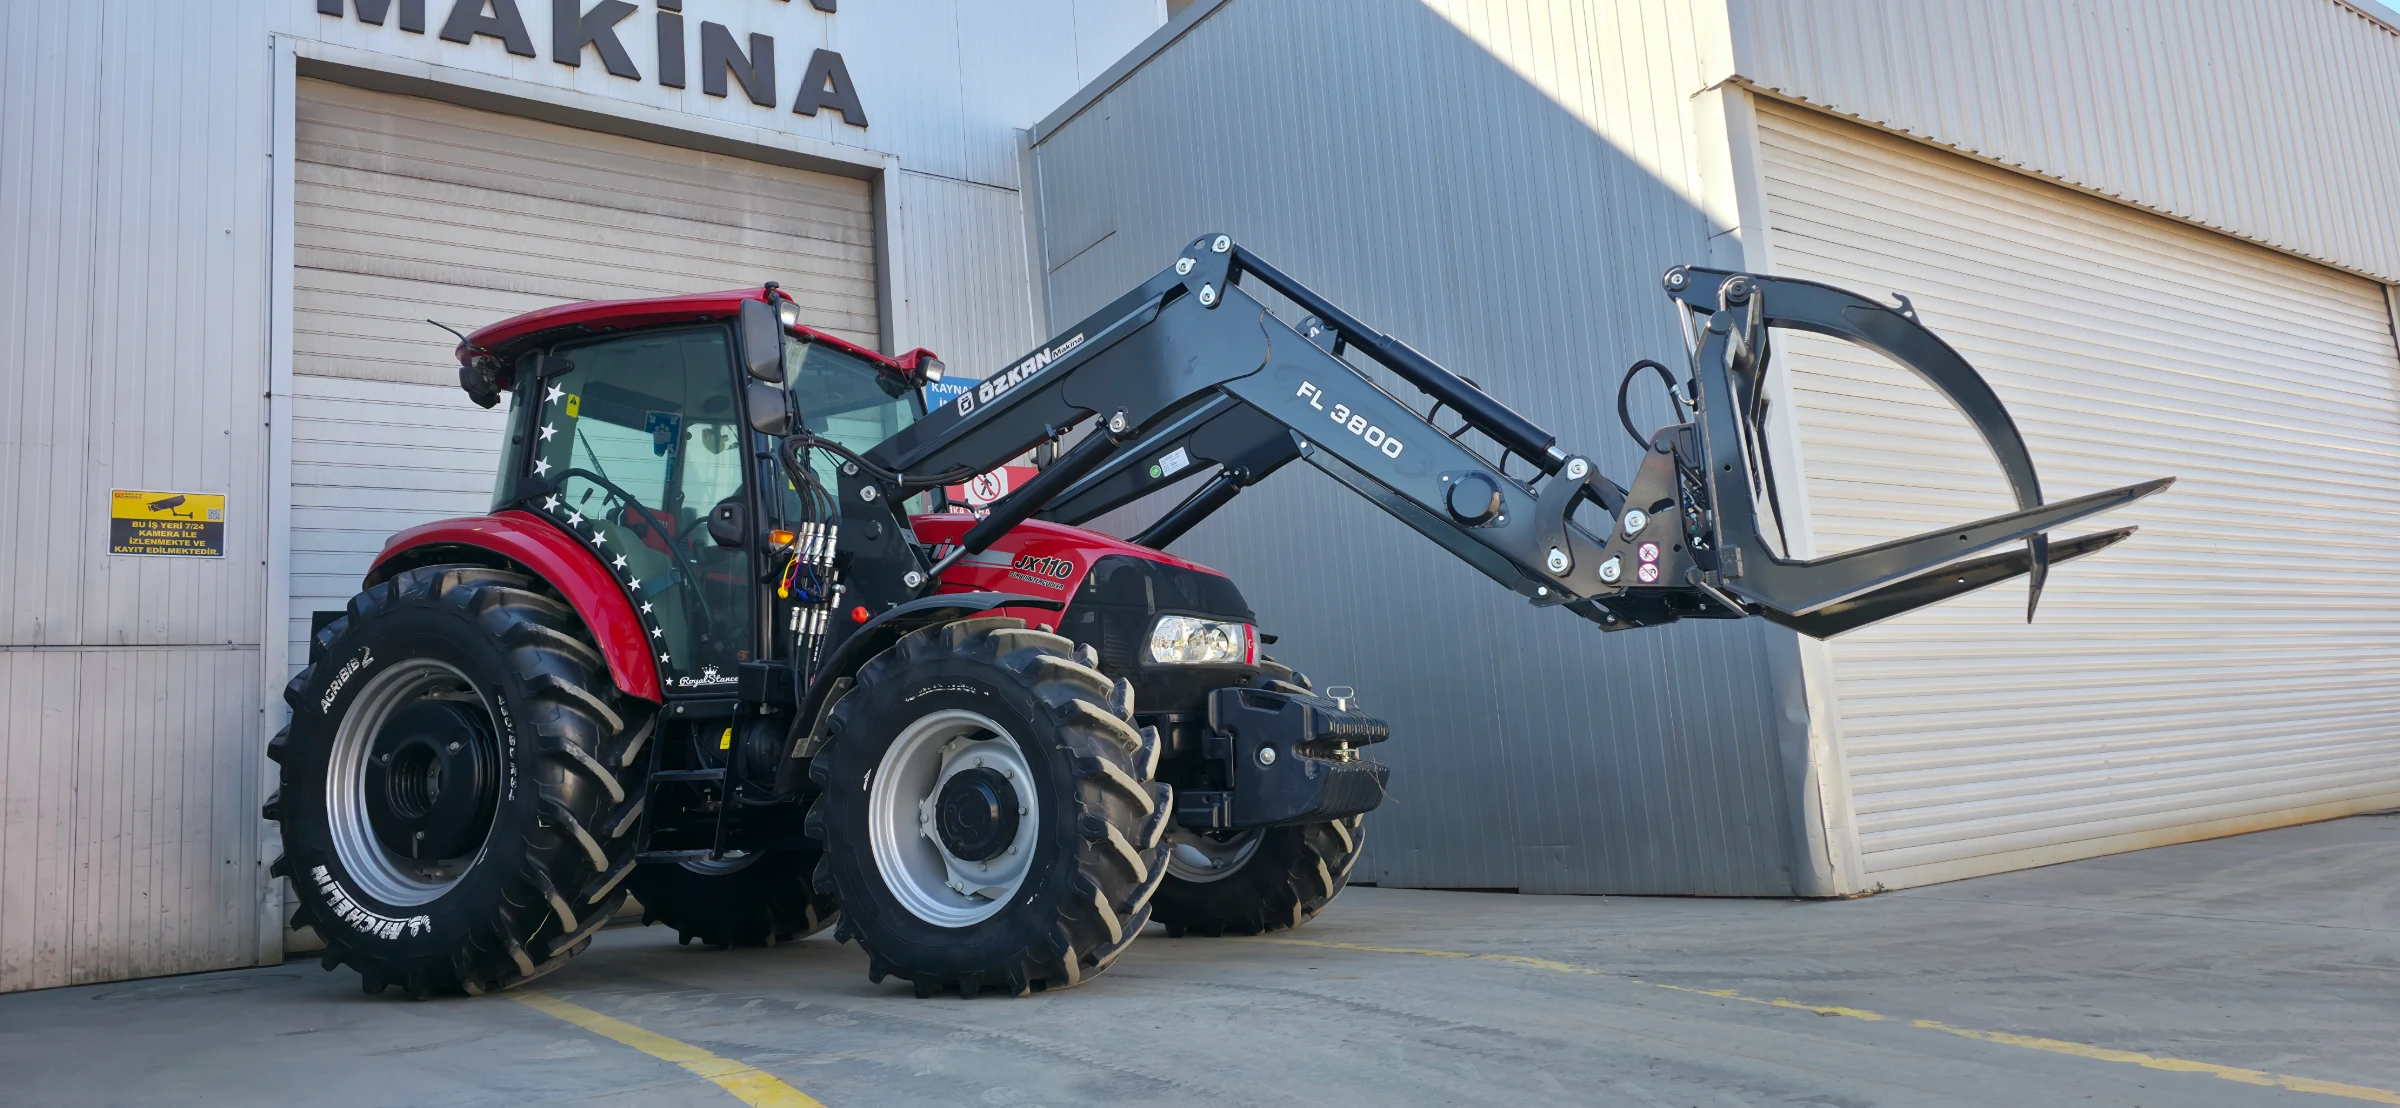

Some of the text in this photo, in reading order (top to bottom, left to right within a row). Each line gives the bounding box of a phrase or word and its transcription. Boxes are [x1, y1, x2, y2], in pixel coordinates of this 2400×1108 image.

[979, 347, 1052, 403] ÖZKAN
[1053, 335, 1083, 360] Makina
[931, 383, 973, 394] KAYNA
[1296, 380, 1404, 459] FL 3800
[148, 520, 158, 530] İŞ
[160, 521, 183, 530] YERİ
[138, 530, 197, 538] KAMERA İLE
[129, 537, 191, 546] İZLENMEKTE
[146, 546, 219, 555] EDİLMEKTEDİR.
[1014, 554, 1074, 579] JX110
[310, 865, 406, 940] MICHELIN
